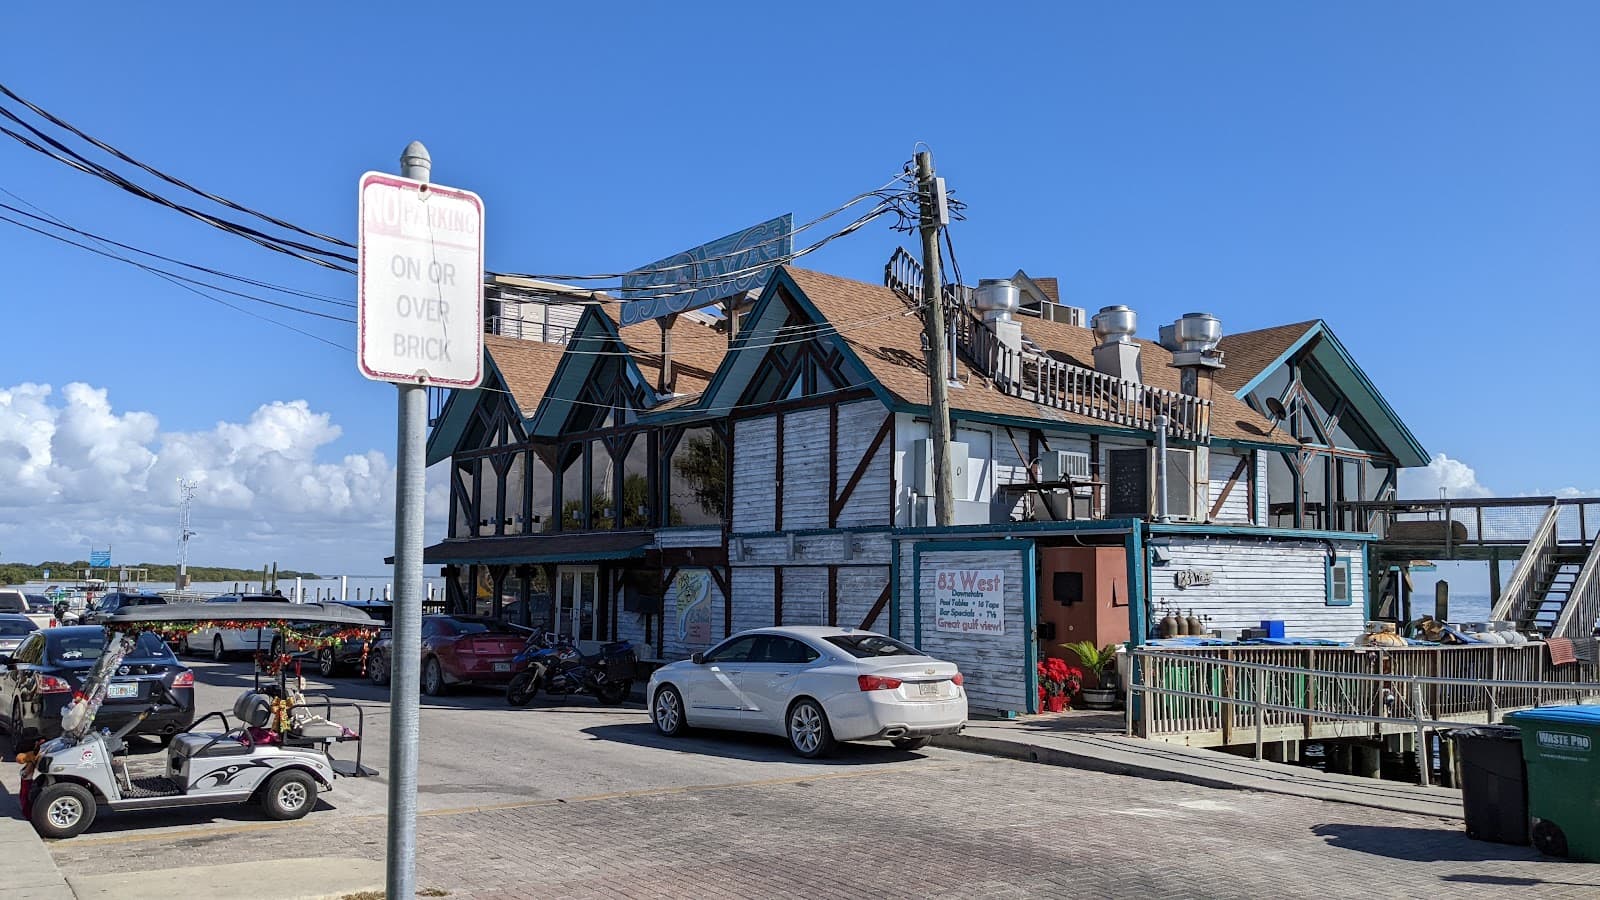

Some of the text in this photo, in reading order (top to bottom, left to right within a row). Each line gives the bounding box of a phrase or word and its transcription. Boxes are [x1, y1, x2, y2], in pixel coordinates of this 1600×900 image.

[369, 191, 475, 233] NO PARKING
[391, 254, 456, 287] ON OR
[396, 294, 451, 325] OVER
[392, 332, 452, 363] BRICK
[938, 571, 1000, 591] 83 West
[952, 589, 983, 597] Downstairs
[939, 607, 950, 616] Bar
[950, 608, 975, 618] Specials
[951, 598, 969, 607] Tables
[985, 600, 1000, 610] Taps
[938, 618, 1001, 631] Great gulf view!
[1540, 732, 1589, 747] WASTE PRO
